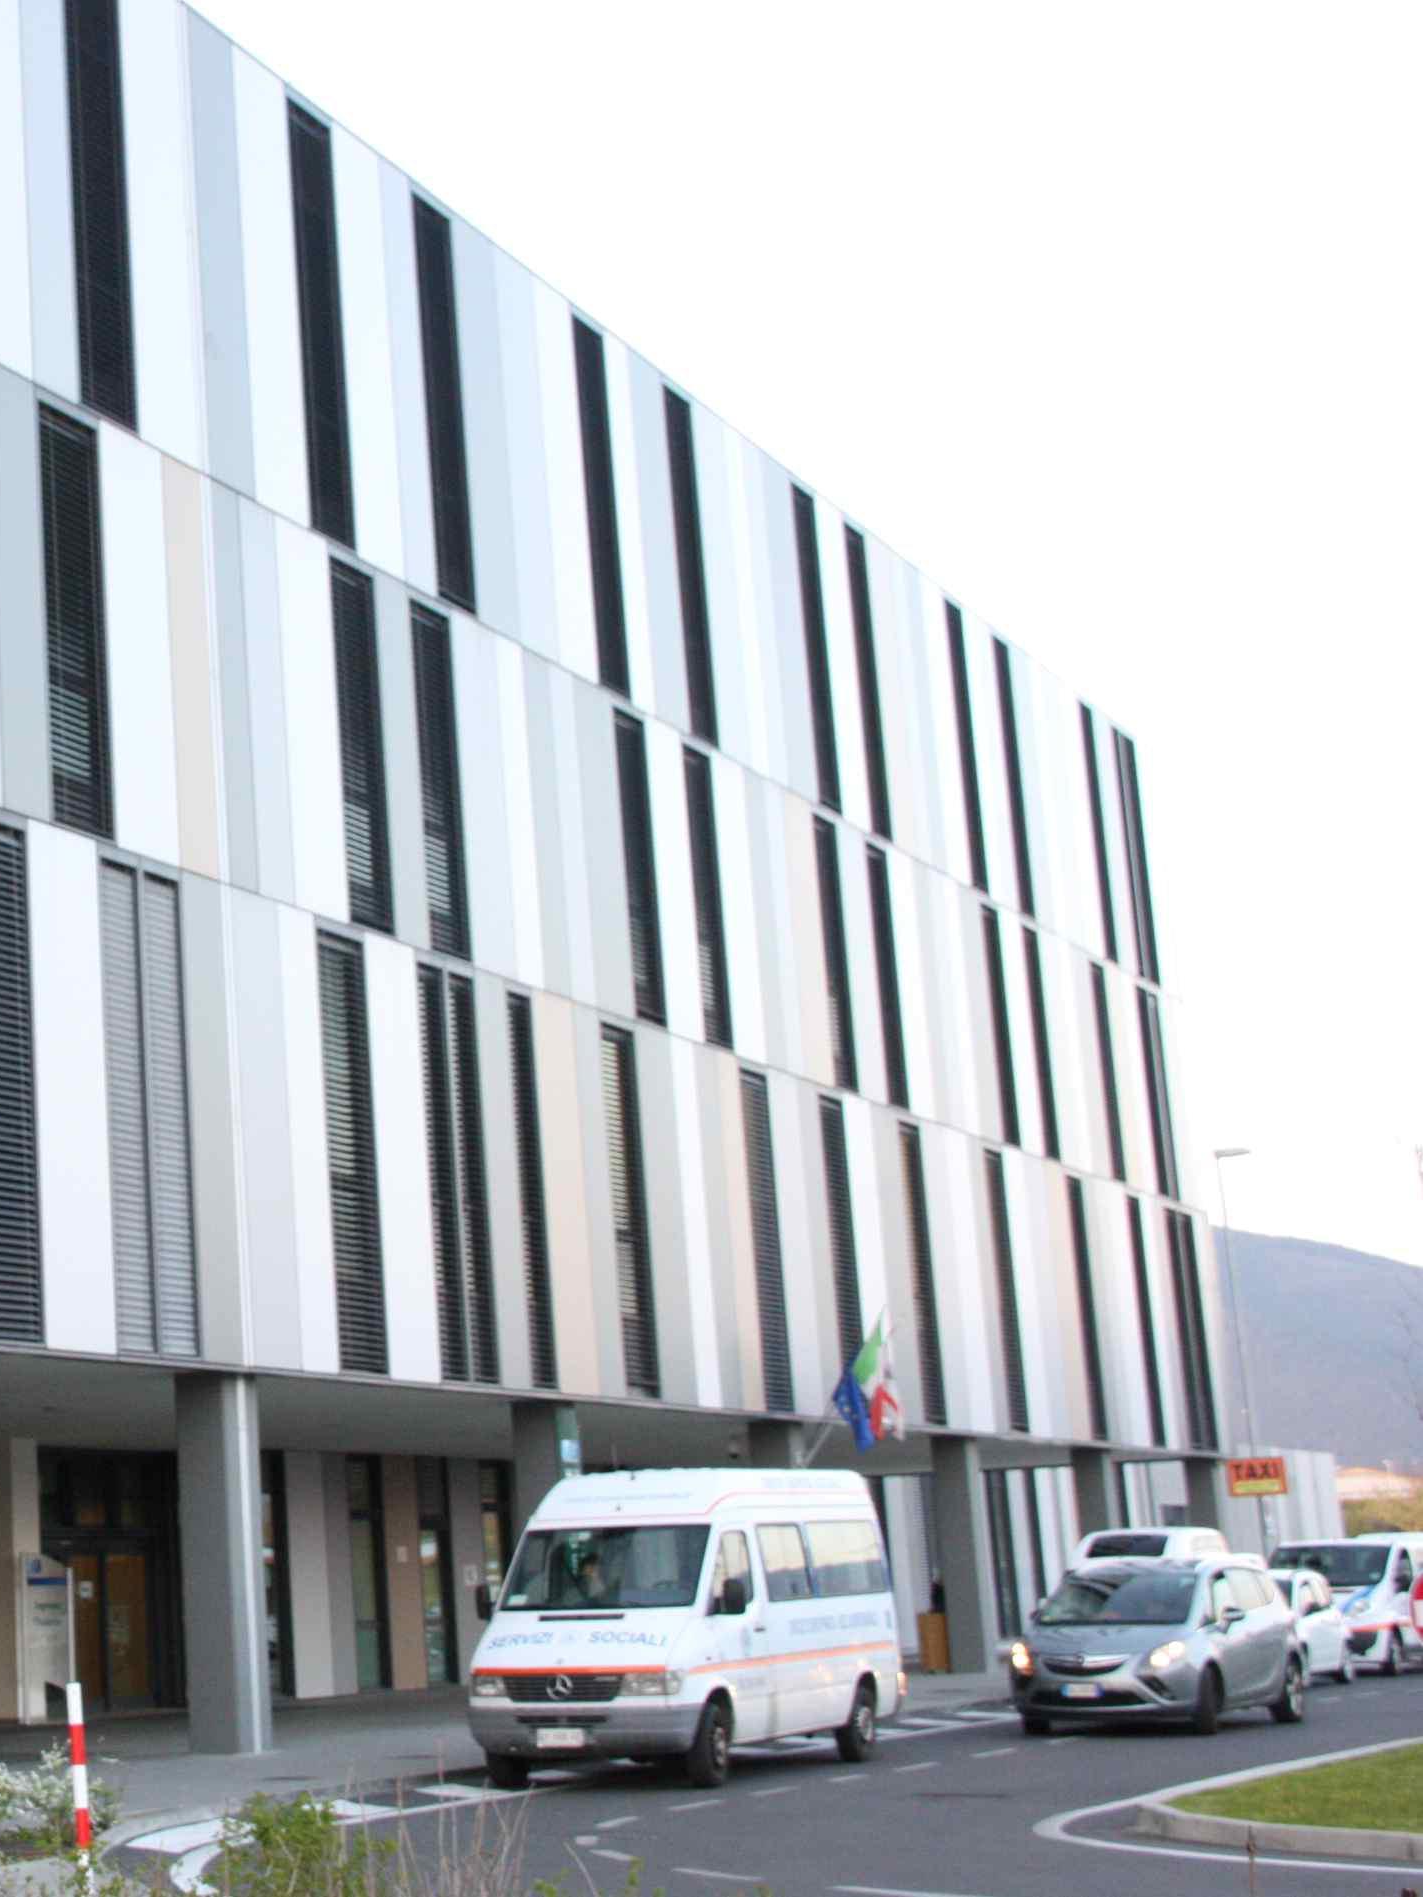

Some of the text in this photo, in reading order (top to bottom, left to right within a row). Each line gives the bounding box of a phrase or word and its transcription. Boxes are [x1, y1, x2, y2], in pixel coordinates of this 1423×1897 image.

[1232, 1463, 1281, 1480] TAXI
[488, 1630, 667, 1650] SERVIZI SOCIALI
